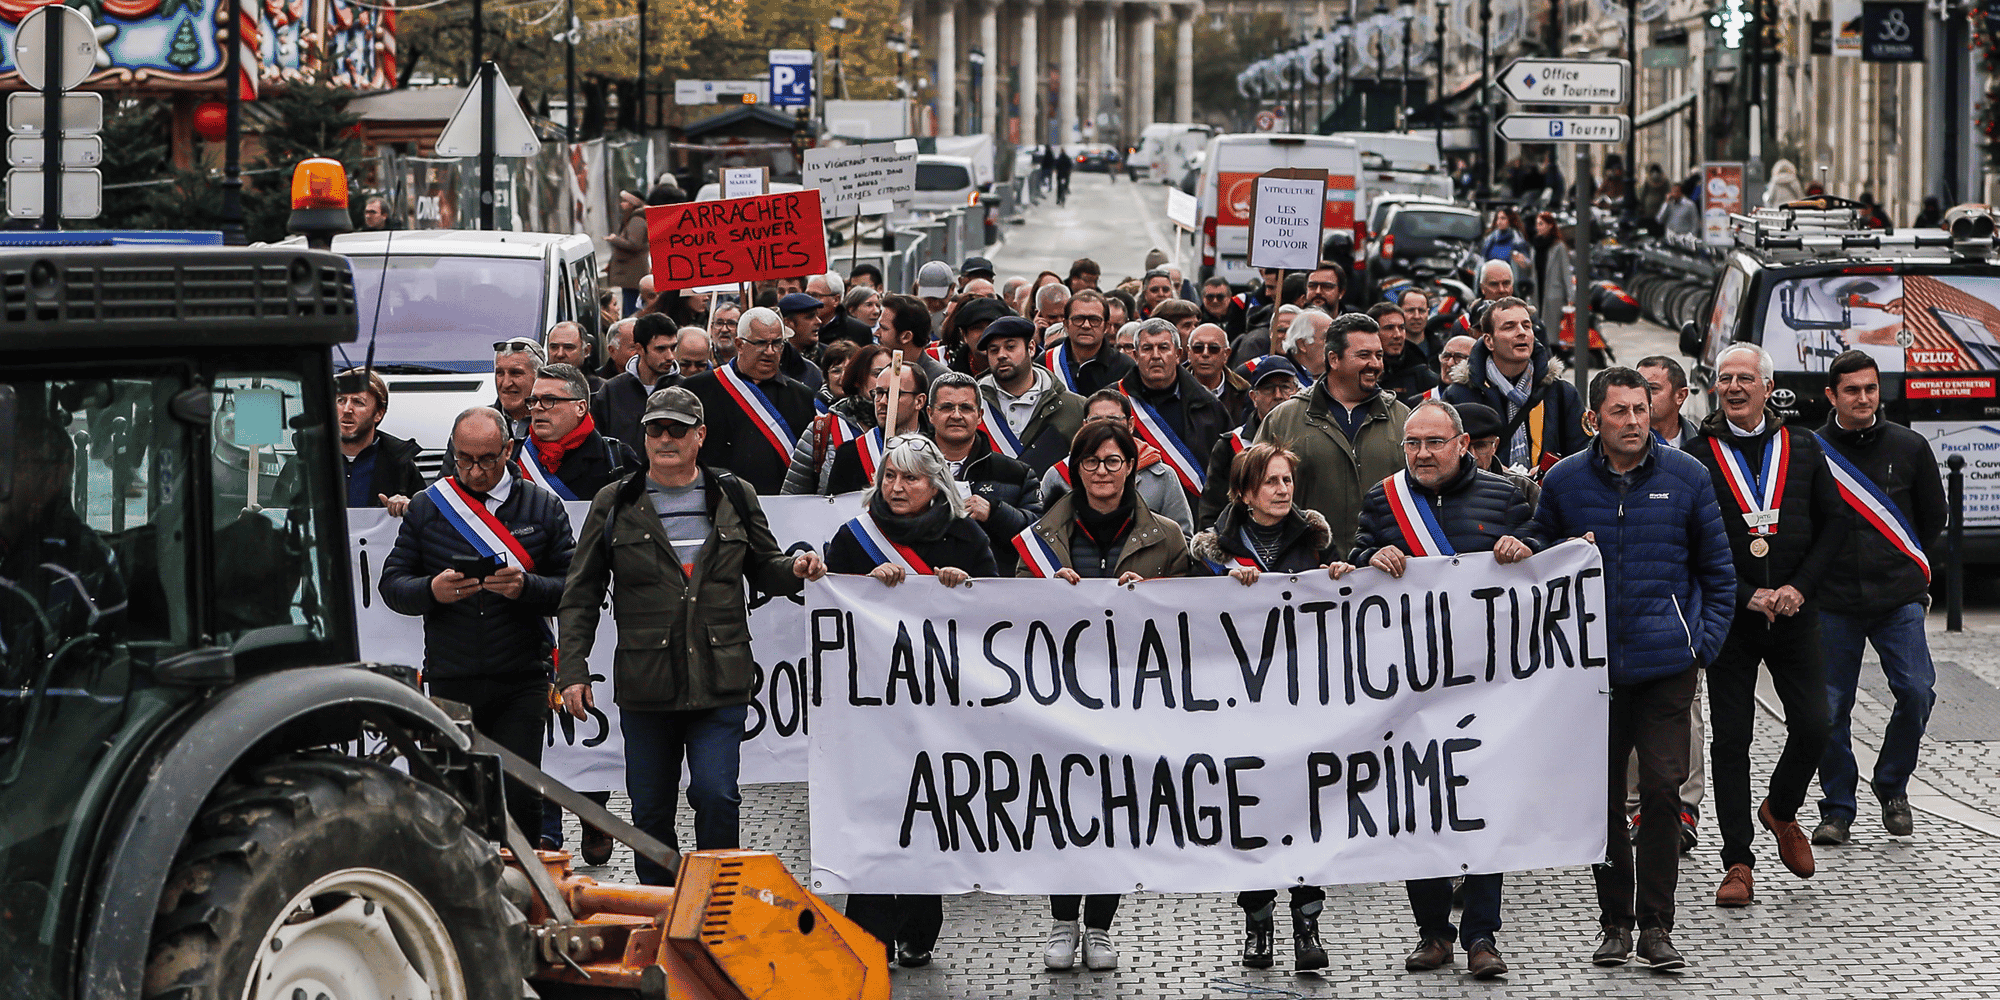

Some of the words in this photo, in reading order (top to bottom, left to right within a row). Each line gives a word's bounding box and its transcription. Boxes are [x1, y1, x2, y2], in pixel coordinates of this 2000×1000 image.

[773, 66, 796, 94] P
[1542, 68, 1579, 80] Office
[1542, 84, 1556, 96] de
[1562, 84, 1617, 97] Tourisme
[1569, 123, 1615, 137] Tourny
[1264, 186, 1315, 195] VITICULTURE
[677, 195, 802, 229] ARRACHER
[1277, 205, 1296, 214] LES
[1264, 215, 1309, 227] OUBLIES
[669, 231, 717, 248] POUR
[729, 221, 797, 243] SAUVER
[1278, 228, 1294, 237] DU
[1261, 239, 1308, 249] POUVOIR
[667, 250, 734, 281] DES
[746, 241, 810, 272] VIES
[1912, 352, 1954, 364] VELUX
[1910, 381, 1944, 389] CONTRAT
[1941, 443, 1971, 451] Pascal
[1307, 713, 1486, 846] PRIMÉ
